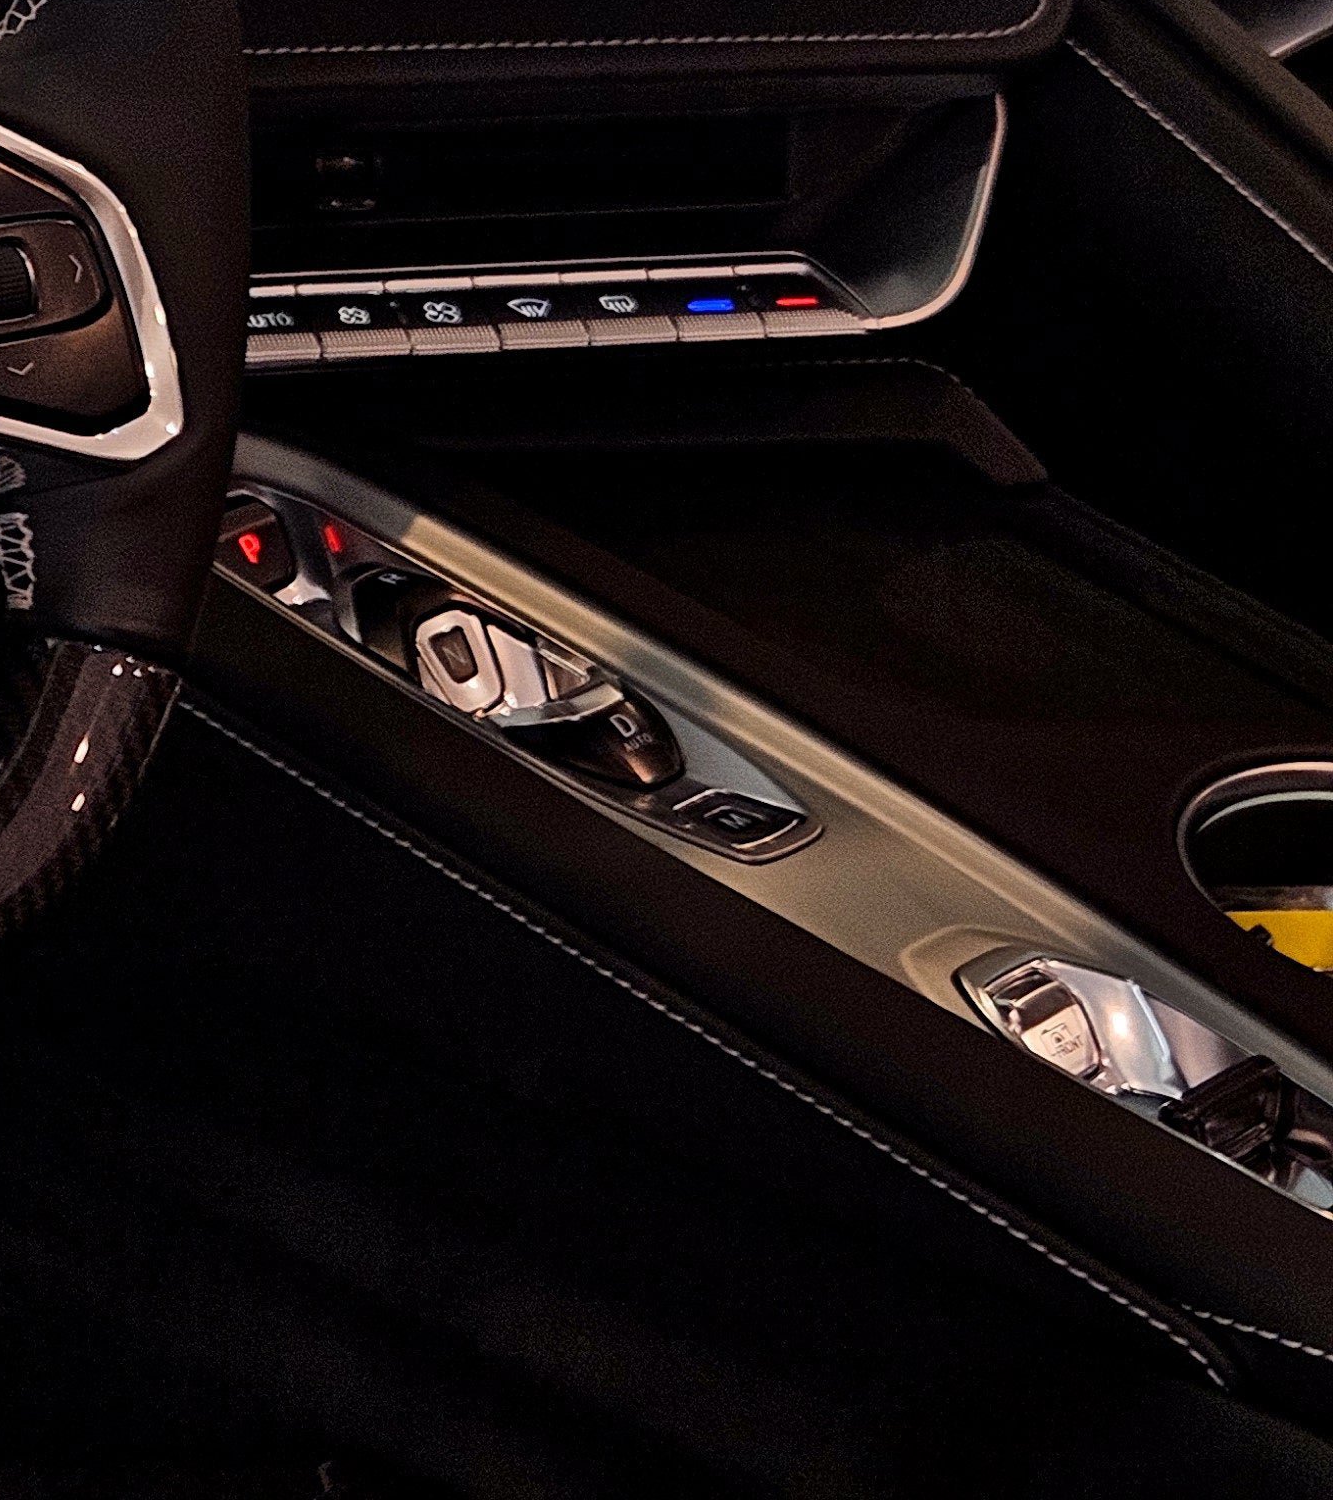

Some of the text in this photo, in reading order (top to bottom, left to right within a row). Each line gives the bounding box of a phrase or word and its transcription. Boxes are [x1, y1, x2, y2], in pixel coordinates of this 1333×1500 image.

[247, 312, 294, 328] UTO
[238, 532, 261, 566] P
[609, 713, 638, 739] D
[717, 813, 753, 830] M
